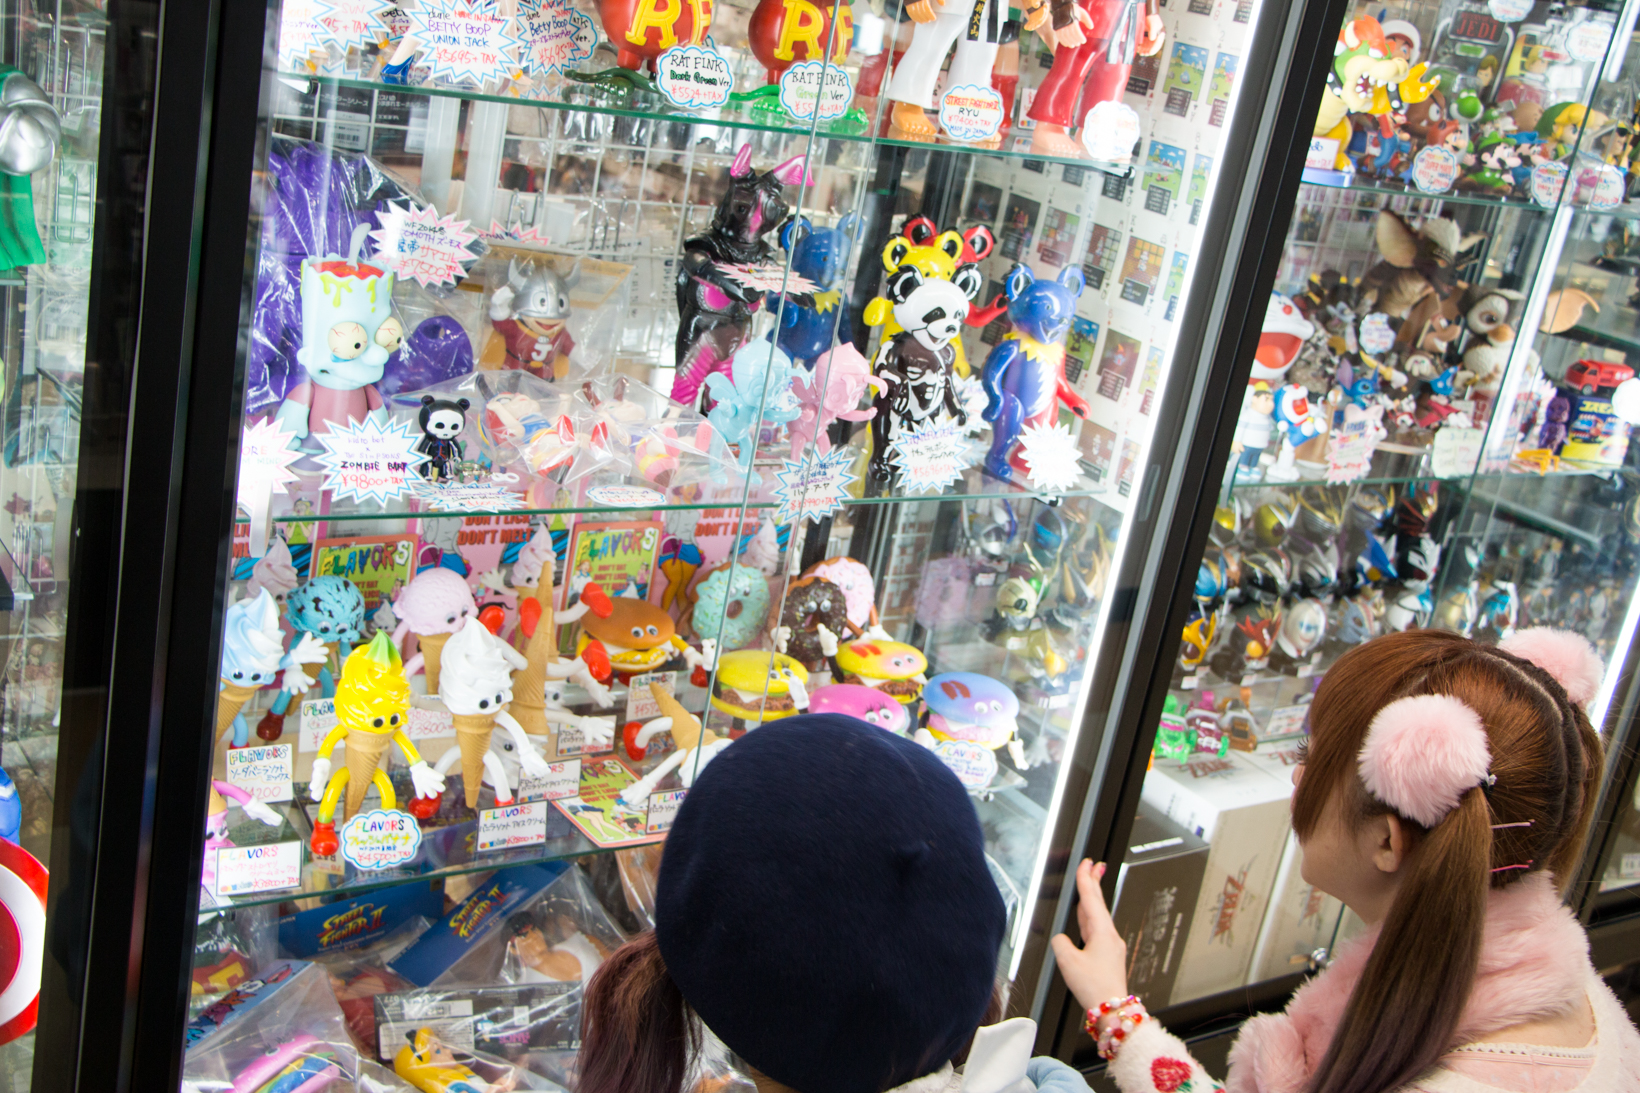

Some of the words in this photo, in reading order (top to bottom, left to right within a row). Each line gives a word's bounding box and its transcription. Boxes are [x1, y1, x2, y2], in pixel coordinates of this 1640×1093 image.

[352, 20, 369, 33] TAX
[428, 20, 461, 33] BETTY
[466, 23, 491, 36] BOOP
[529, 21, 551, 37] Betty
[552, 15, 568, 31] Boop
[1456, 20, 1498, 40] JEDI
[433, 35, 460, 45] UNION
[464, 37, 490, 47] JACK
[480, 53, 497, 65] TAX
[671, 55, 690, 68] RAT
[694, 57, 723, 73] FINK
[670, 69, 691, 82] Dark
[694, 72, 717, 86] Green
[792, 72, 814, 84] RAT
[831, 90, 844, 100] Ver.
[945, 95, 969, 106] STREET
[795, 101, 826, 114] ¥554
[959, 107, 979, 117] RYU
[401, 229, 435, 244] OMOTH
[531, 343, 553, 361] J
[340, 460, 380, 472] ZOMBIE
[341, 473, 384, 489] ¥9800
[390, 476, 404, 485] TAX
[457, 530, 498, 545] DON'T
[500, 528, 533, 543] MELT
[695, 522, 730, 536] DON'T
[577, 527, 655, 565] FLAVORS
[320, 540, 409, 577] FLAVORS
[303, 701, 336, 716] FLAV
[229, 745, 288, 765] FLAVORS
[942, 747, 982, 761] FLAVORS
[657, 791, 687, 804] FLAVO
[485, 805, 532, 822] FLAVORS
[355, 819, 405, 833] FLAVORS
[220, 845, 278, 862] FLAVORS
[317, 903, 374, 938] STREET
[449, 891, 486, 935] STREET
[459, 900, 492, 937] FIGHTER
[319, 917, 371, 947] FIGHTER
